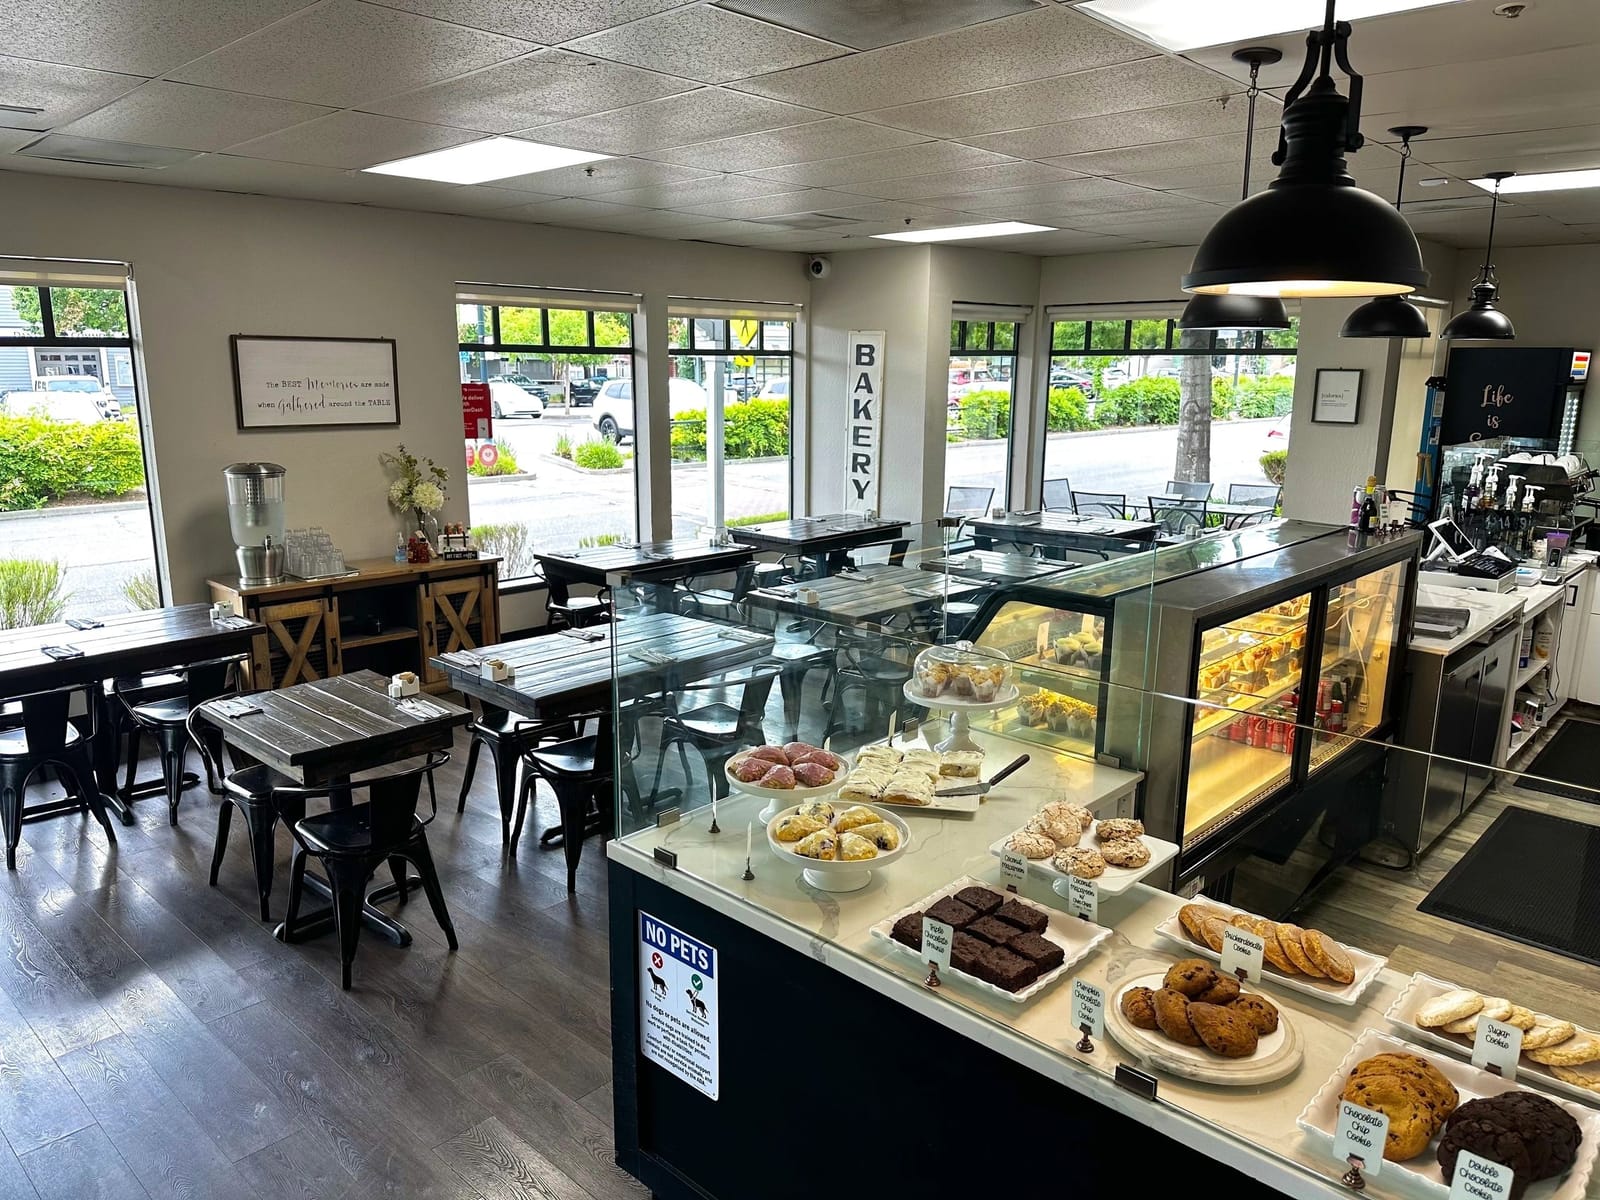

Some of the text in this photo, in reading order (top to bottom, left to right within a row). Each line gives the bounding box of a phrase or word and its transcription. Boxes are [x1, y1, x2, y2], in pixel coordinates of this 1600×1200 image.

[1481, 384, 1514, 408] Life
[853, 344, 875, 500] BAKERY
[1488, 414, 1502, 428] is
[646, 920, 708, 970] NO PETS
[1488, 1024, 1510, 1038] Sugar
[1486, 1034, 1509, 1049] Cookie
[1344, 1106, 1383, 1128] Chocolate
[1352, 1120, 1370, 1136] Chip
[1346, 1130, 1372, 1148] Cookie
[1468, 1159, 1499, 1178] Double
[1460, 1168, 1504, 1192] Chocolate
